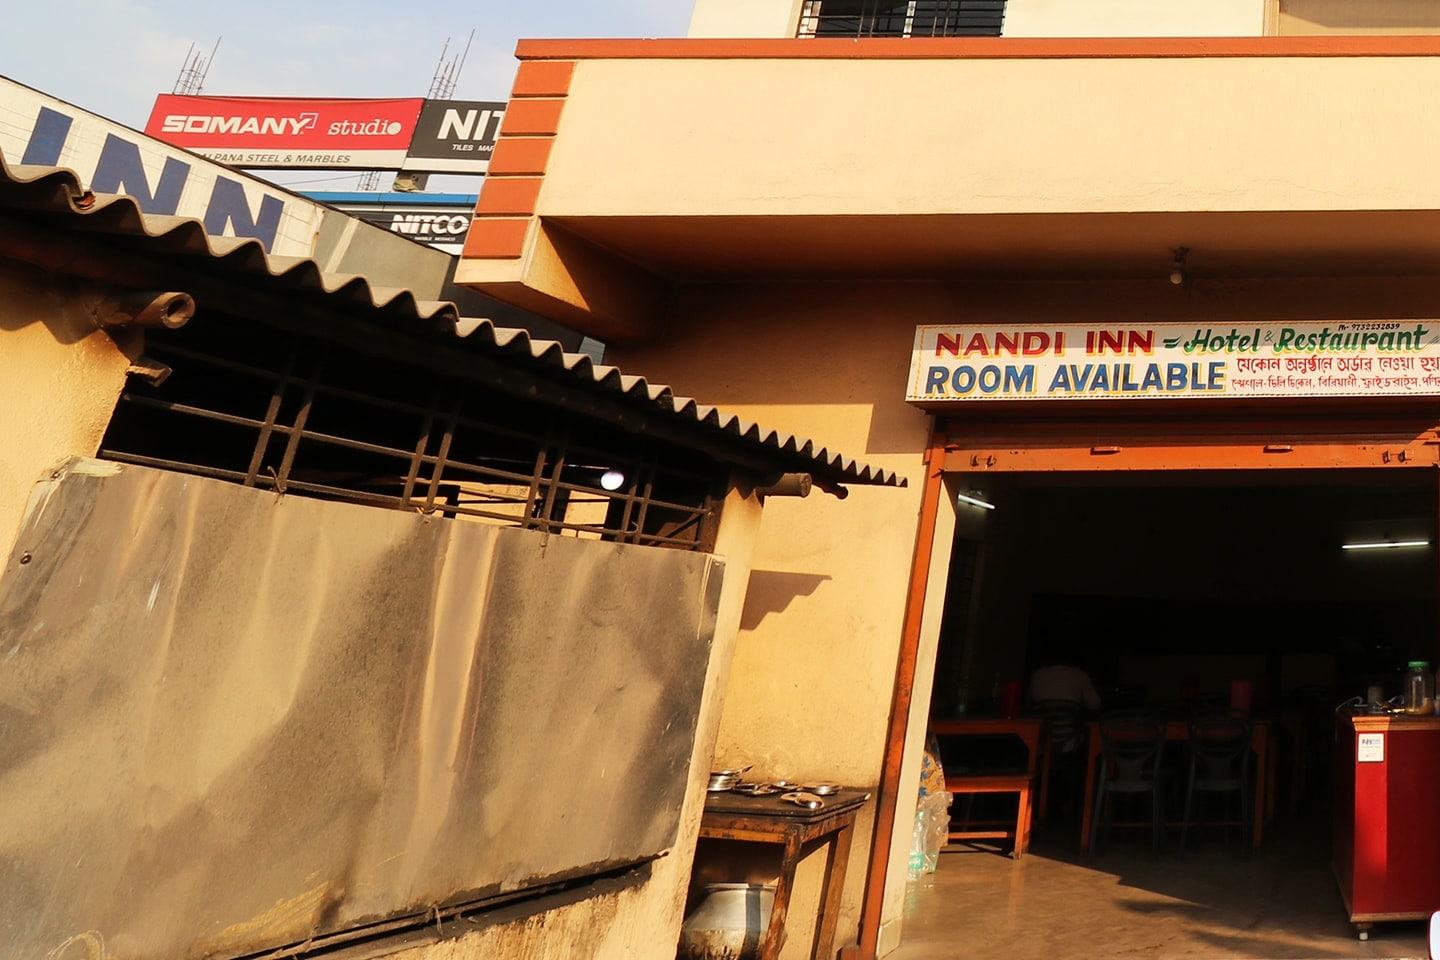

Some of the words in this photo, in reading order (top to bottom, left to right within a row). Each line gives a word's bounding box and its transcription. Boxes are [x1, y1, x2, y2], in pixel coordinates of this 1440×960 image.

[161, 114, 312, 136] SOMANY
[327, 118, 402, 137] studio
[247, 153, 281, 163] STEEL
[283, 154, 294, 164] &
[296, 154, 352, 164] MARBLES
[452, 143, 474, 152] TILES
[20, 105, 285, 255] INN
[390, 214, 469, 235] NITCO
[935, 331, 1064, 356] NANDI
[1086, 329, 1154, 355] INN
[1183, 329, 1260, 353] Hotel
[1273, 324, 1429, 353] Restaurant
[925, 364, 1036, 394] ROOM
[1049, 362, 1226, 393] AVAILABLE
